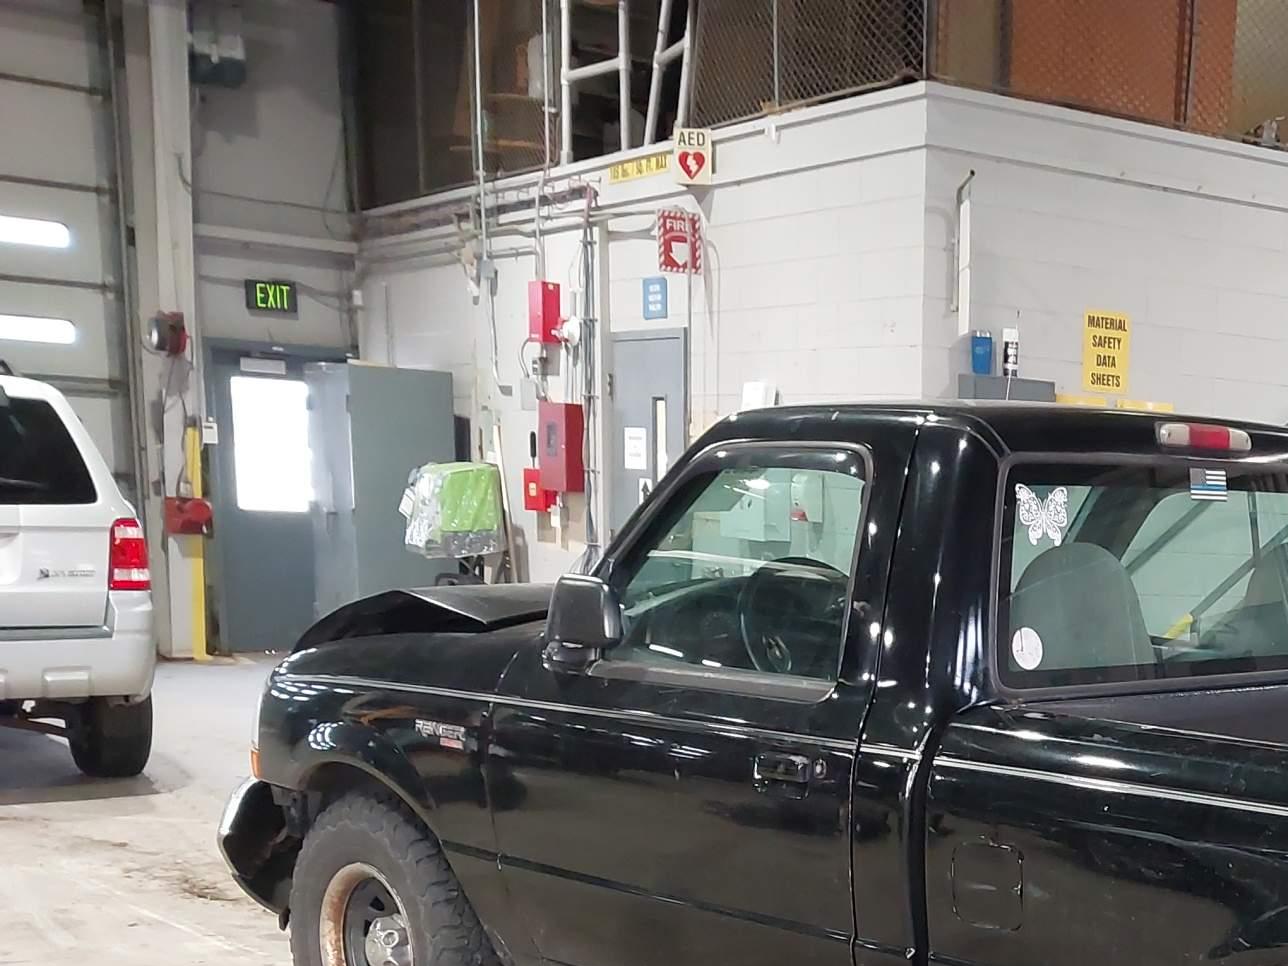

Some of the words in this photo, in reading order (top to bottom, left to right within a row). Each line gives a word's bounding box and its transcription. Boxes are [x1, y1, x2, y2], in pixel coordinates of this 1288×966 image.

[677, 131, 706, 147] AED
[256, 283, 290, 310] EXIT
[1087, 314, 1127, 332] MATERIAL
[1092, 335, 1122, 350] SAFETY
[1096, 354, 1116, 369] DATA
[1091, 372, 1121, 388] SHEETS
